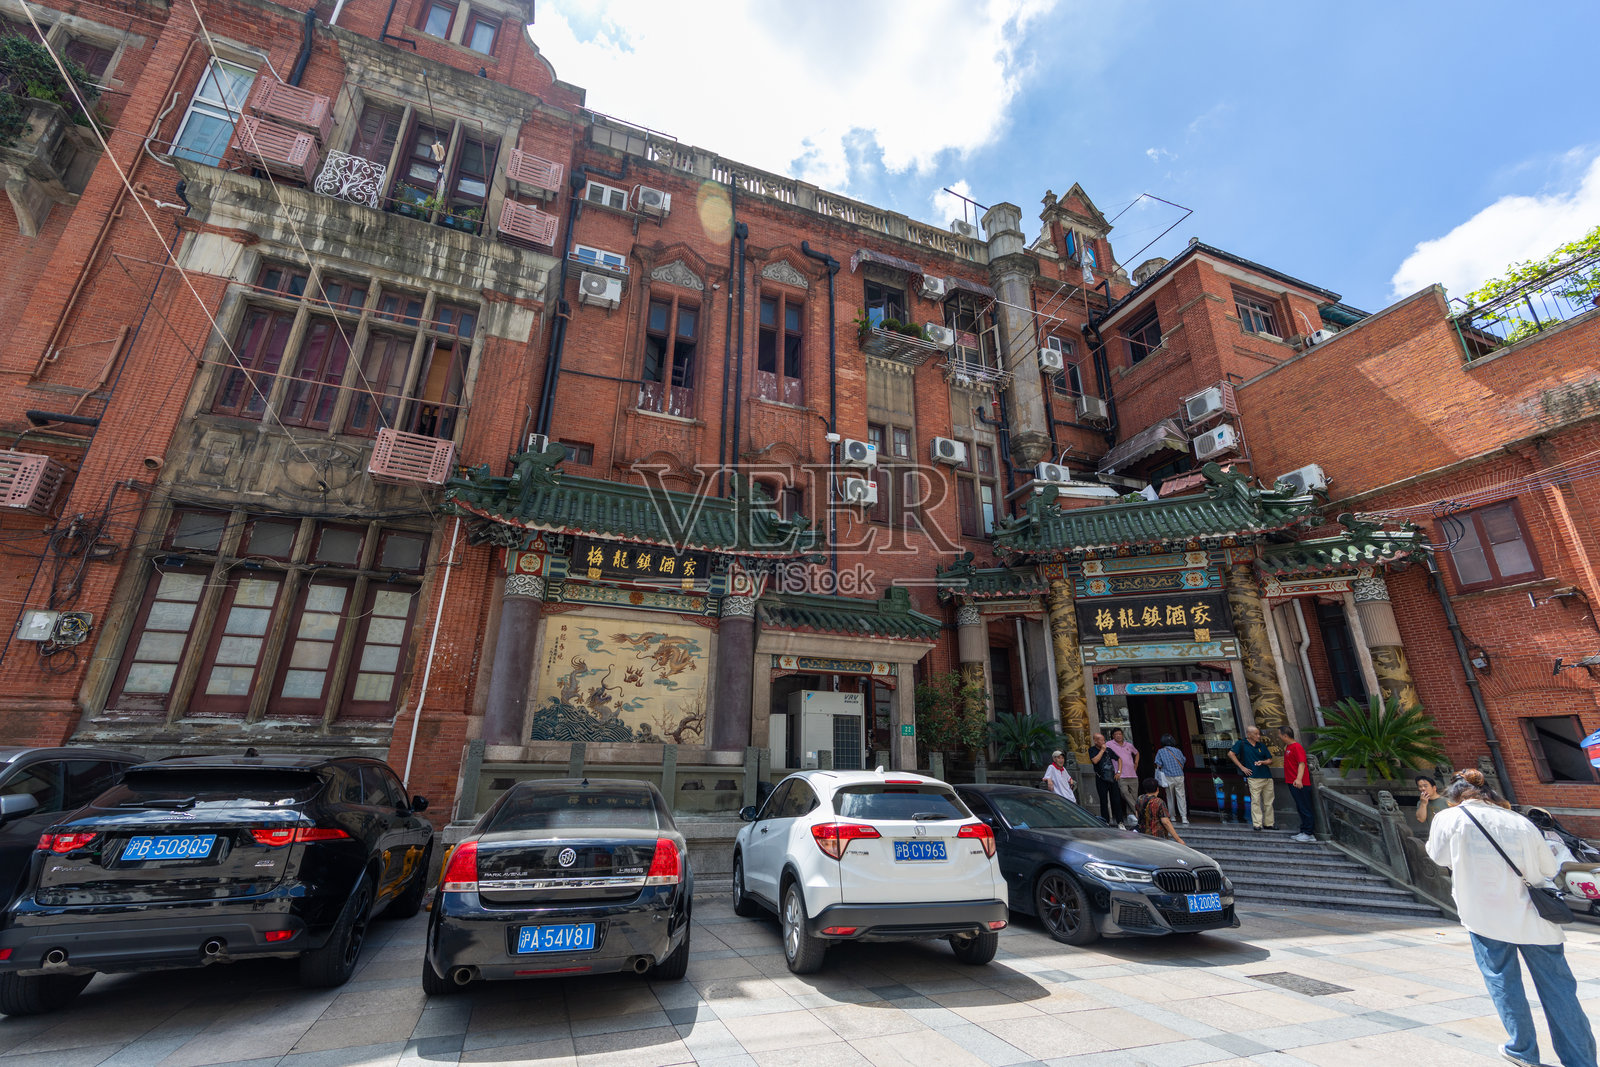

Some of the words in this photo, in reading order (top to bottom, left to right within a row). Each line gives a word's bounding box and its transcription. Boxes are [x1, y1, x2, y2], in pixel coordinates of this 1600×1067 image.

[587, 545, 697, 576] 梅龍鎮酒家
[1095, 602, 1211, 631] 梅龍鎮酒家
